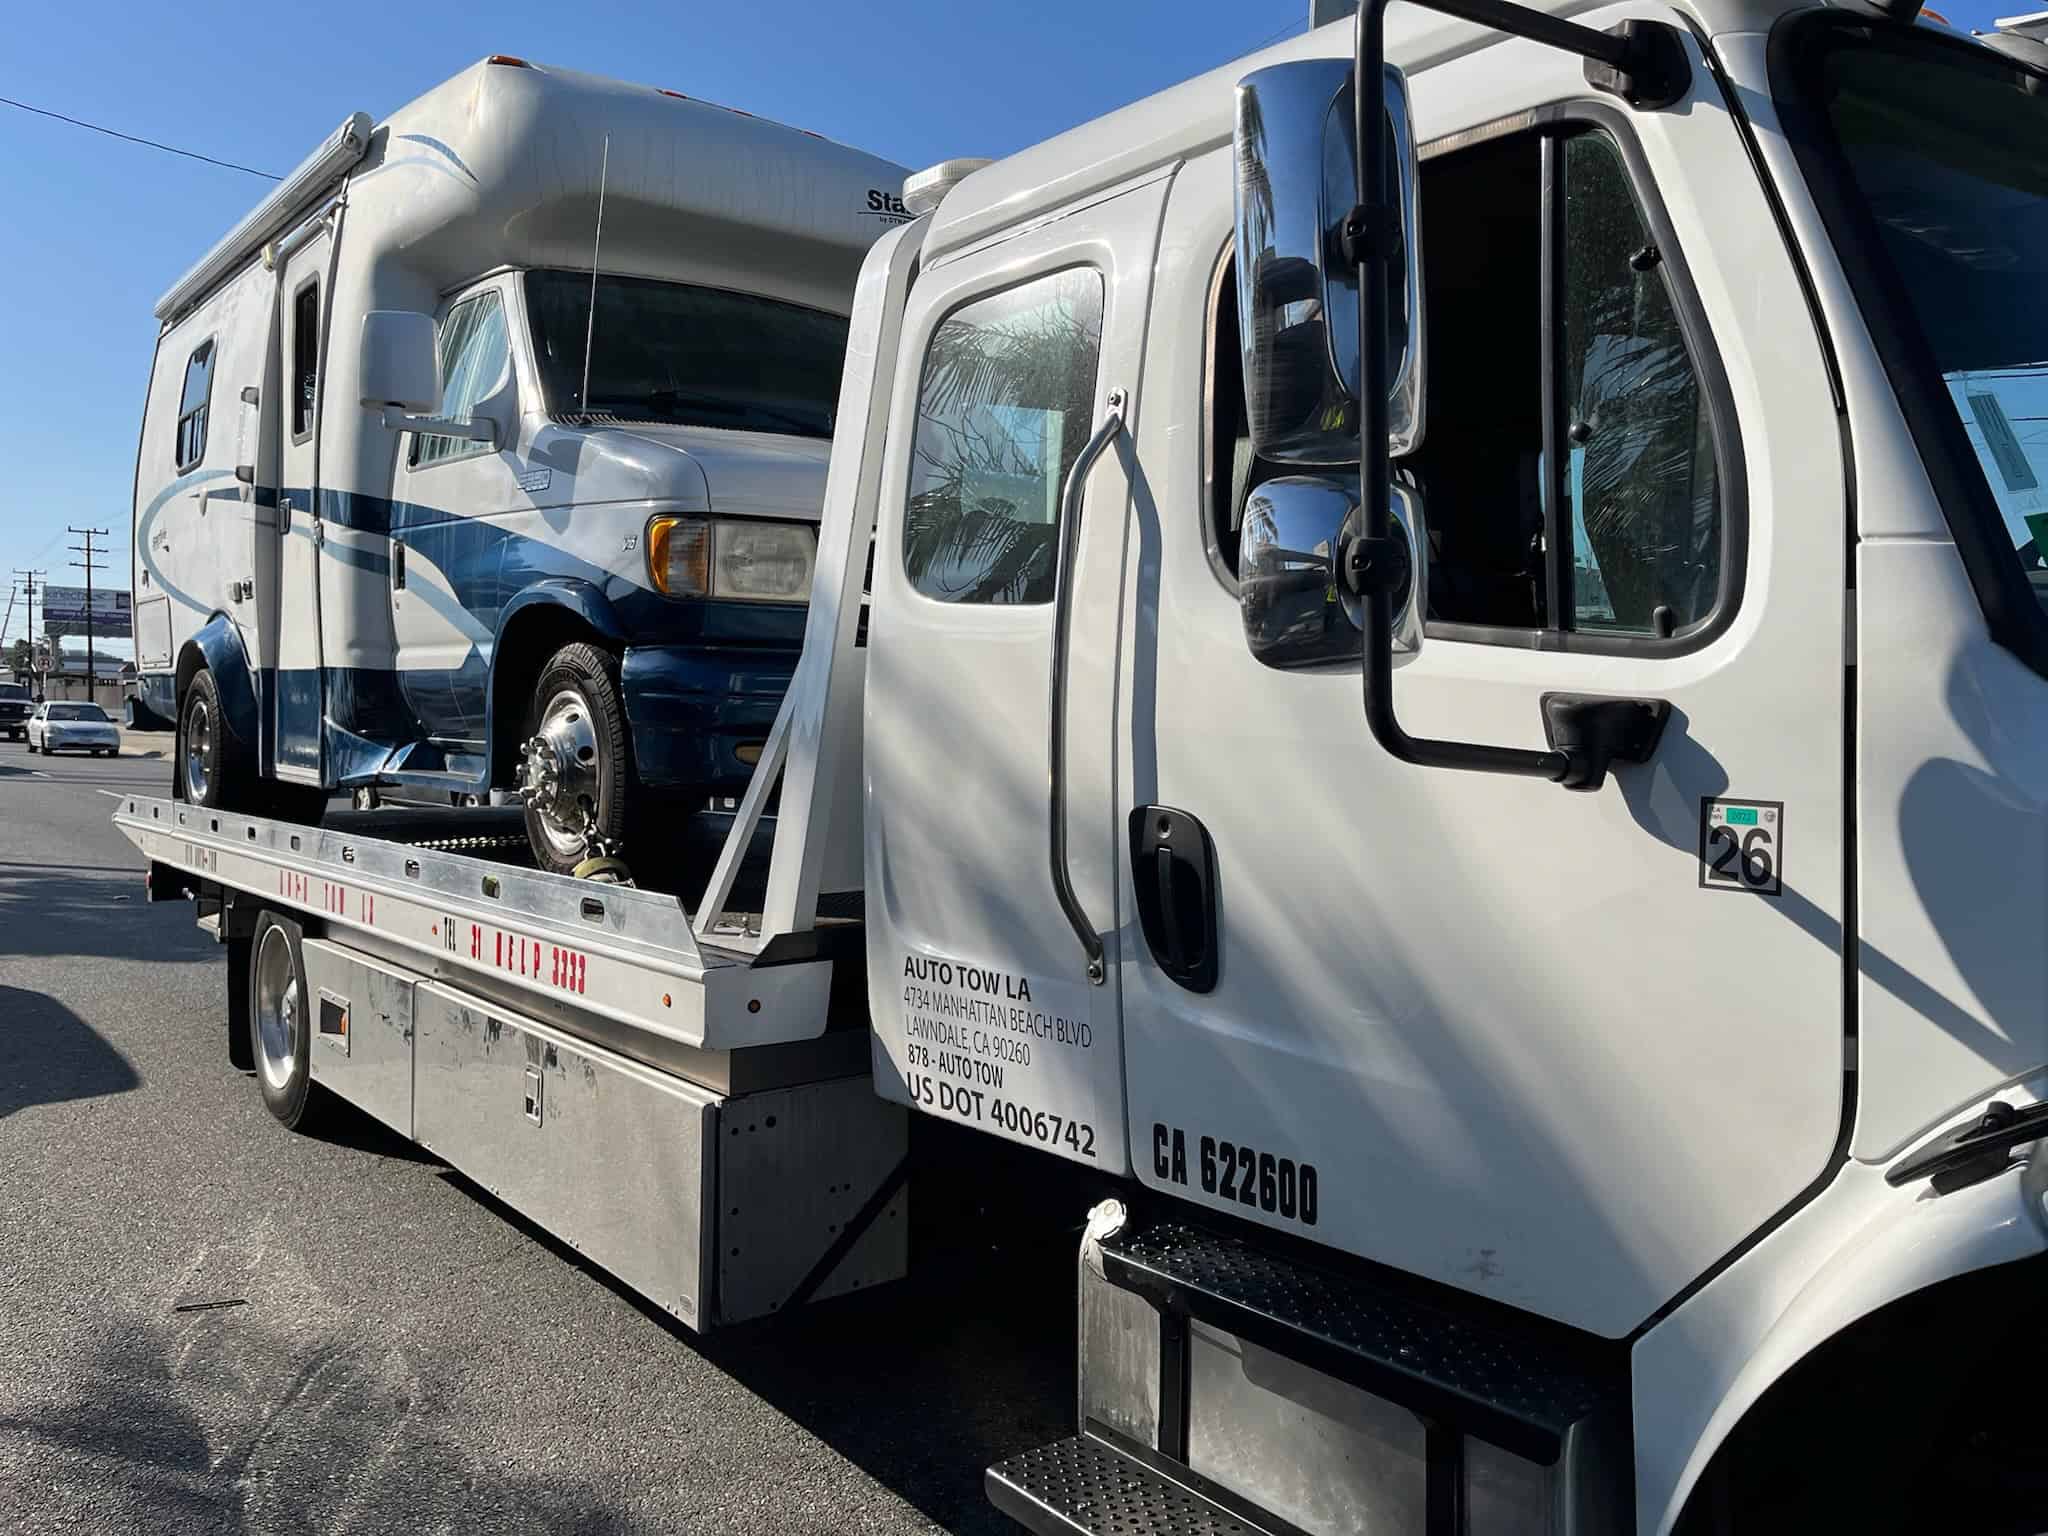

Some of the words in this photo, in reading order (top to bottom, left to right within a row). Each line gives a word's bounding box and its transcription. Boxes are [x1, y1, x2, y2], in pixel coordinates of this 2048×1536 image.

[867, 189, 912, 214] Sta
[1709, 825, 1773, 886] 26
[552, 946, 586, 995] 3333
[904, 956, 952, 985] AUTO
[956, 966, 1000, 995] TOW
[1006, 975, 1031, 1002] LA
[904, 986, 930, 1011] 4734
[932, 991, 1007, 1029] MANHATTAN
[1010, 1008, 1053, 1040] BEACH
[1057, 1018, 1092, 1048] BLVD
[906, 1014, 971, 1051] LAWNDALE,
[973, 1030, 990, 1057] CA
[993, 1035, 1031, 1066] 90260
[908, 1044, 929, 1068] 878
[938, 1051, 972, 1080] AUTO
[974, 1059, 1004, 1089] TOW
[907, 1071, 934, 1105] US
[939, 1080, 984, 1121] DOT
[991, 1098, 1097, 1158] 4006742
[1152, 1122, 1188, 1186] CA
[1200, 1135, 1318, 1226] 622600
